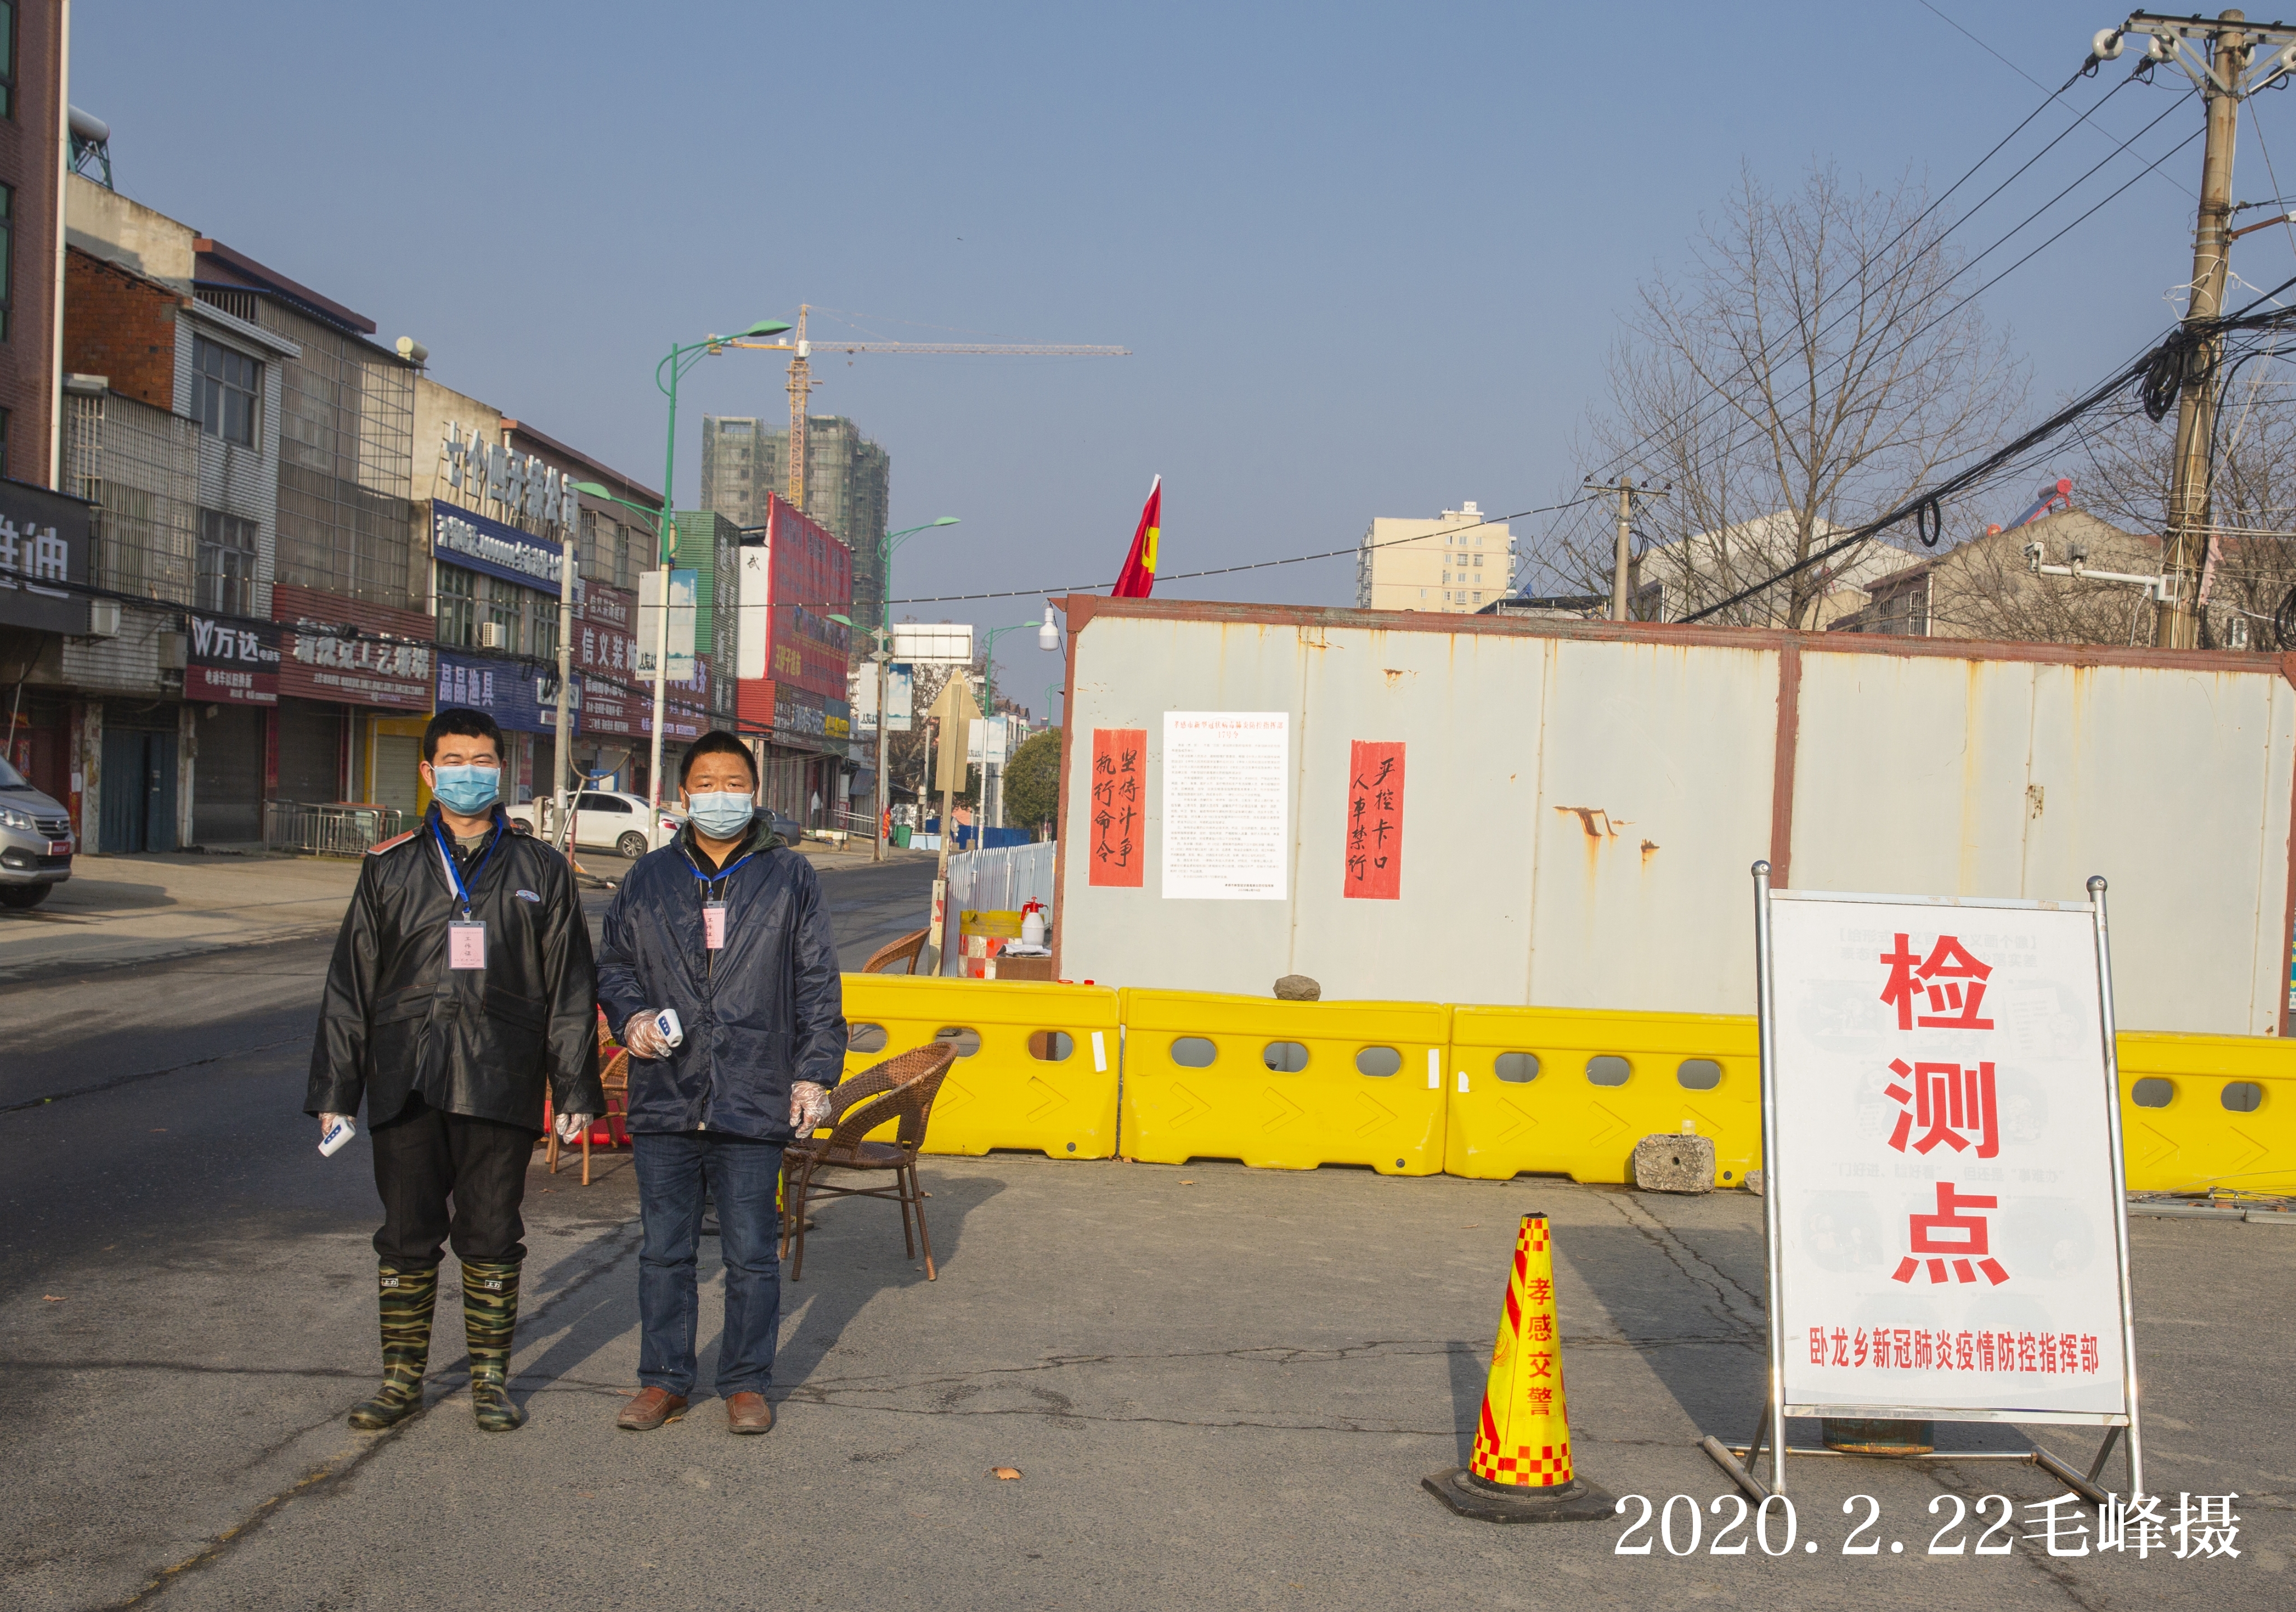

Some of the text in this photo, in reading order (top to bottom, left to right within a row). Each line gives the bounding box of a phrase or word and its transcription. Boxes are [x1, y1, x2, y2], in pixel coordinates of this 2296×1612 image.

[213, 626, 259, 662] 万达
[259, 649, 281, 662] 电动车
[582, 626, 637, 675] 信义装饰
[439, 663, 494, 706] 晶晶渔具
[1174, 720, 1284, 729] 孝感市新型冠状病毒肺炎防控指挥部
[1094, 751, 1116, 862] 执行命令
[1372, 757, 1395, 869] 严控卡口
[1880, 932, 2010, 1286] 检测点
[1527, 1277, 1553, 1416] 孝感交警
[1809, 1325, 2099, 1375] 卧龙乡新冠肺炎疫情防控指挥部
